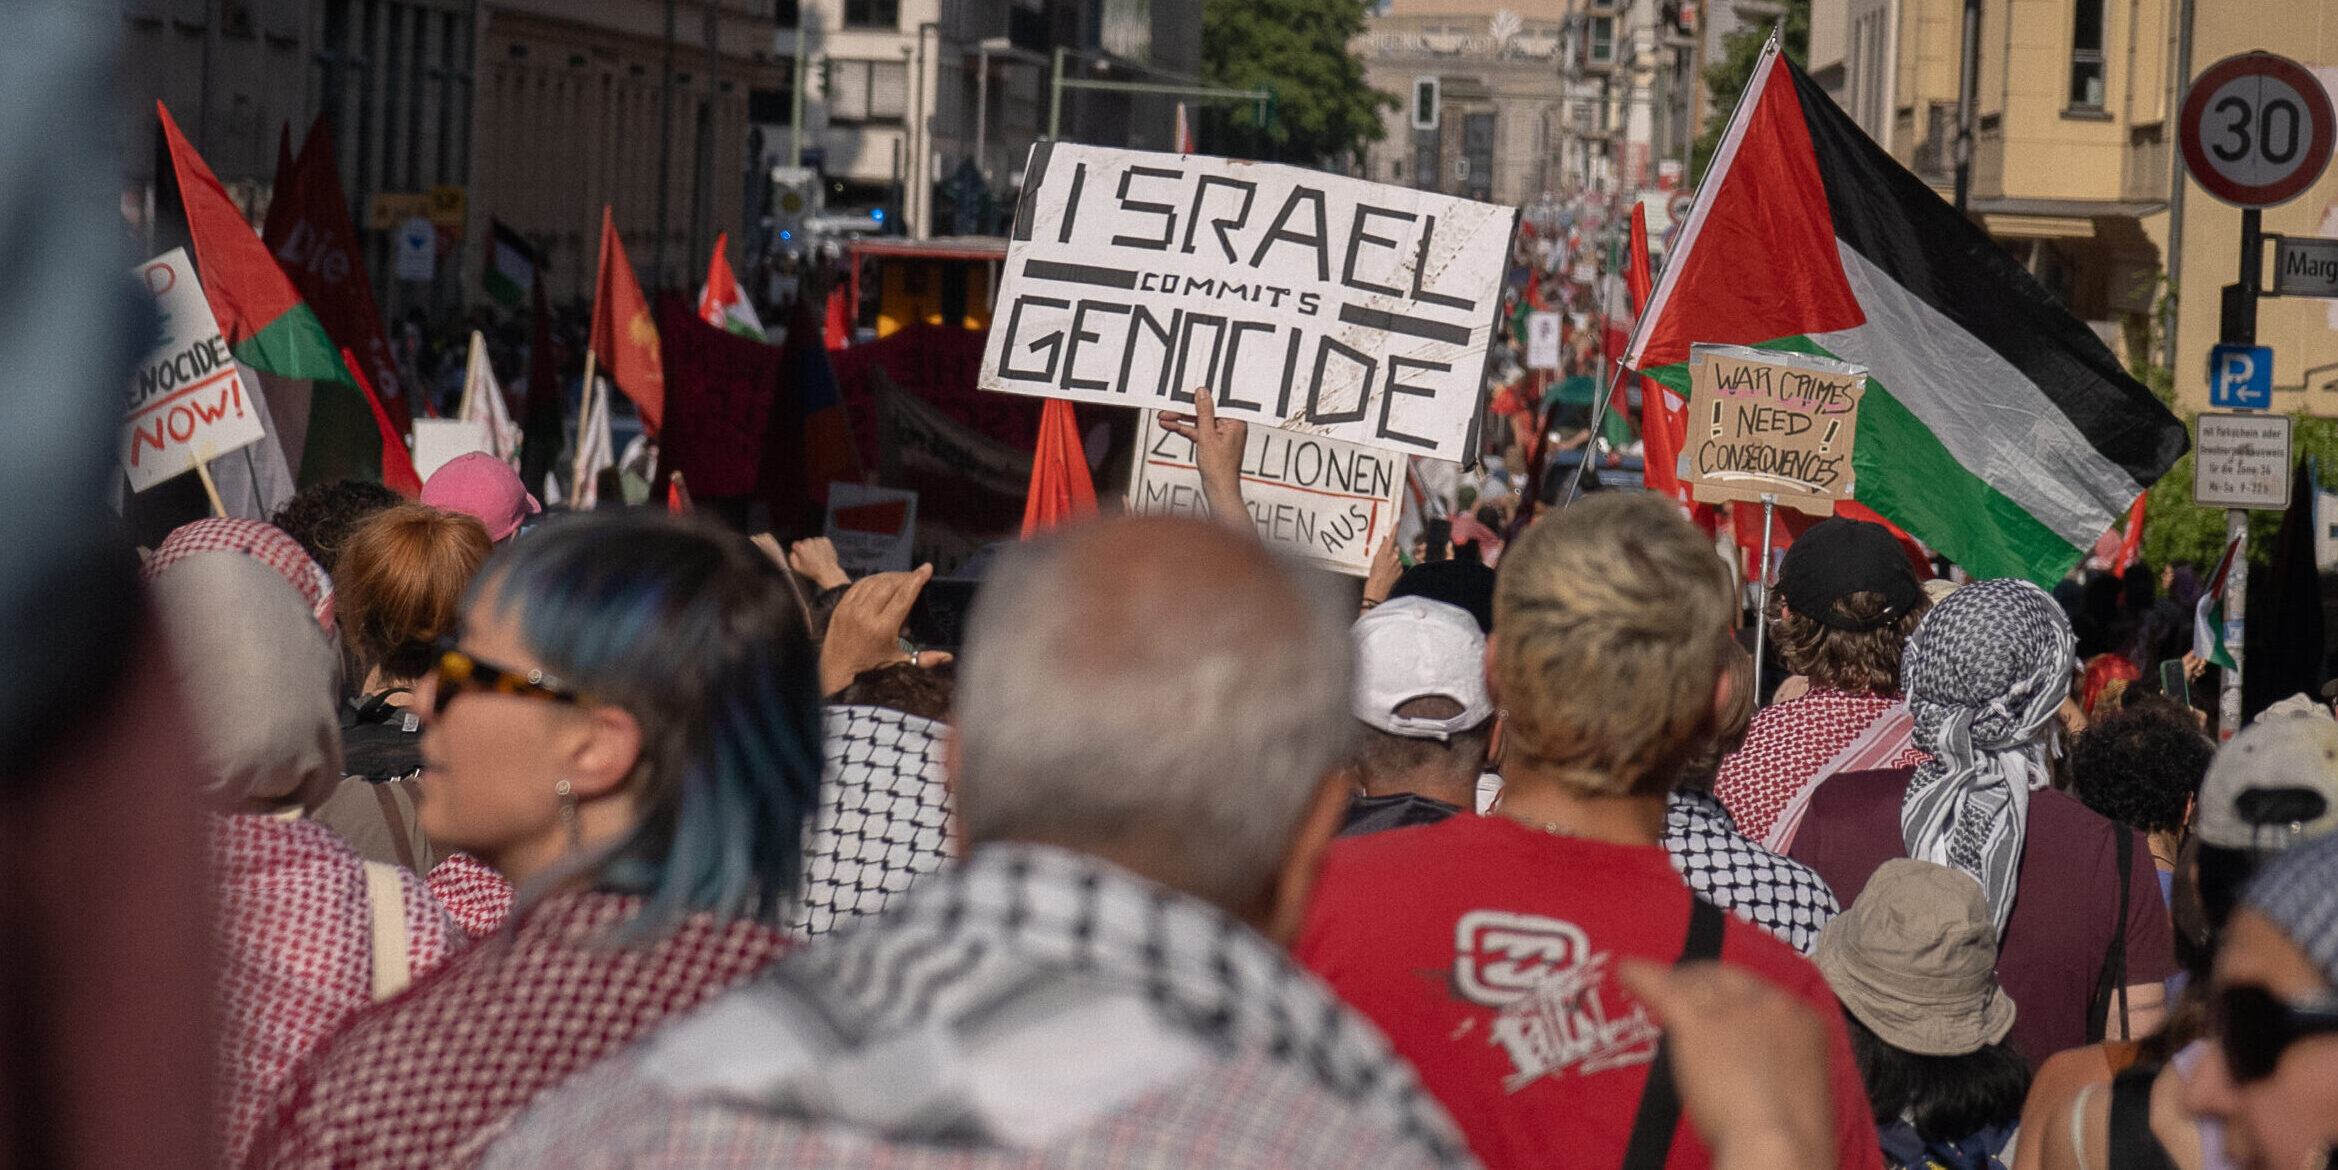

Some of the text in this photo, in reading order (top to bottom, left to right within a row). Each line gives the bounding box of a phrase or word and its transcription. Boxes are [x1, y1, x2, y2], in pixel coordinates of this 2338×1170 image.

[2211, 96, 2299, 164] 30
[1059, 163, 1475, 311] ISRAEL
[1140, 272, 1321, 316] COMMITS
[2286, 250, 2338, 284] Marg
[999, 295, 1452, 450] GENOCIDE
[1716, 363, 1855, 415] WAR CRIMES
[131, 379, 243, 467] NOW!
[1737, 404, 1812, 438] NEED
[1699, 440, 1844, 494] CONSEQUENCES
